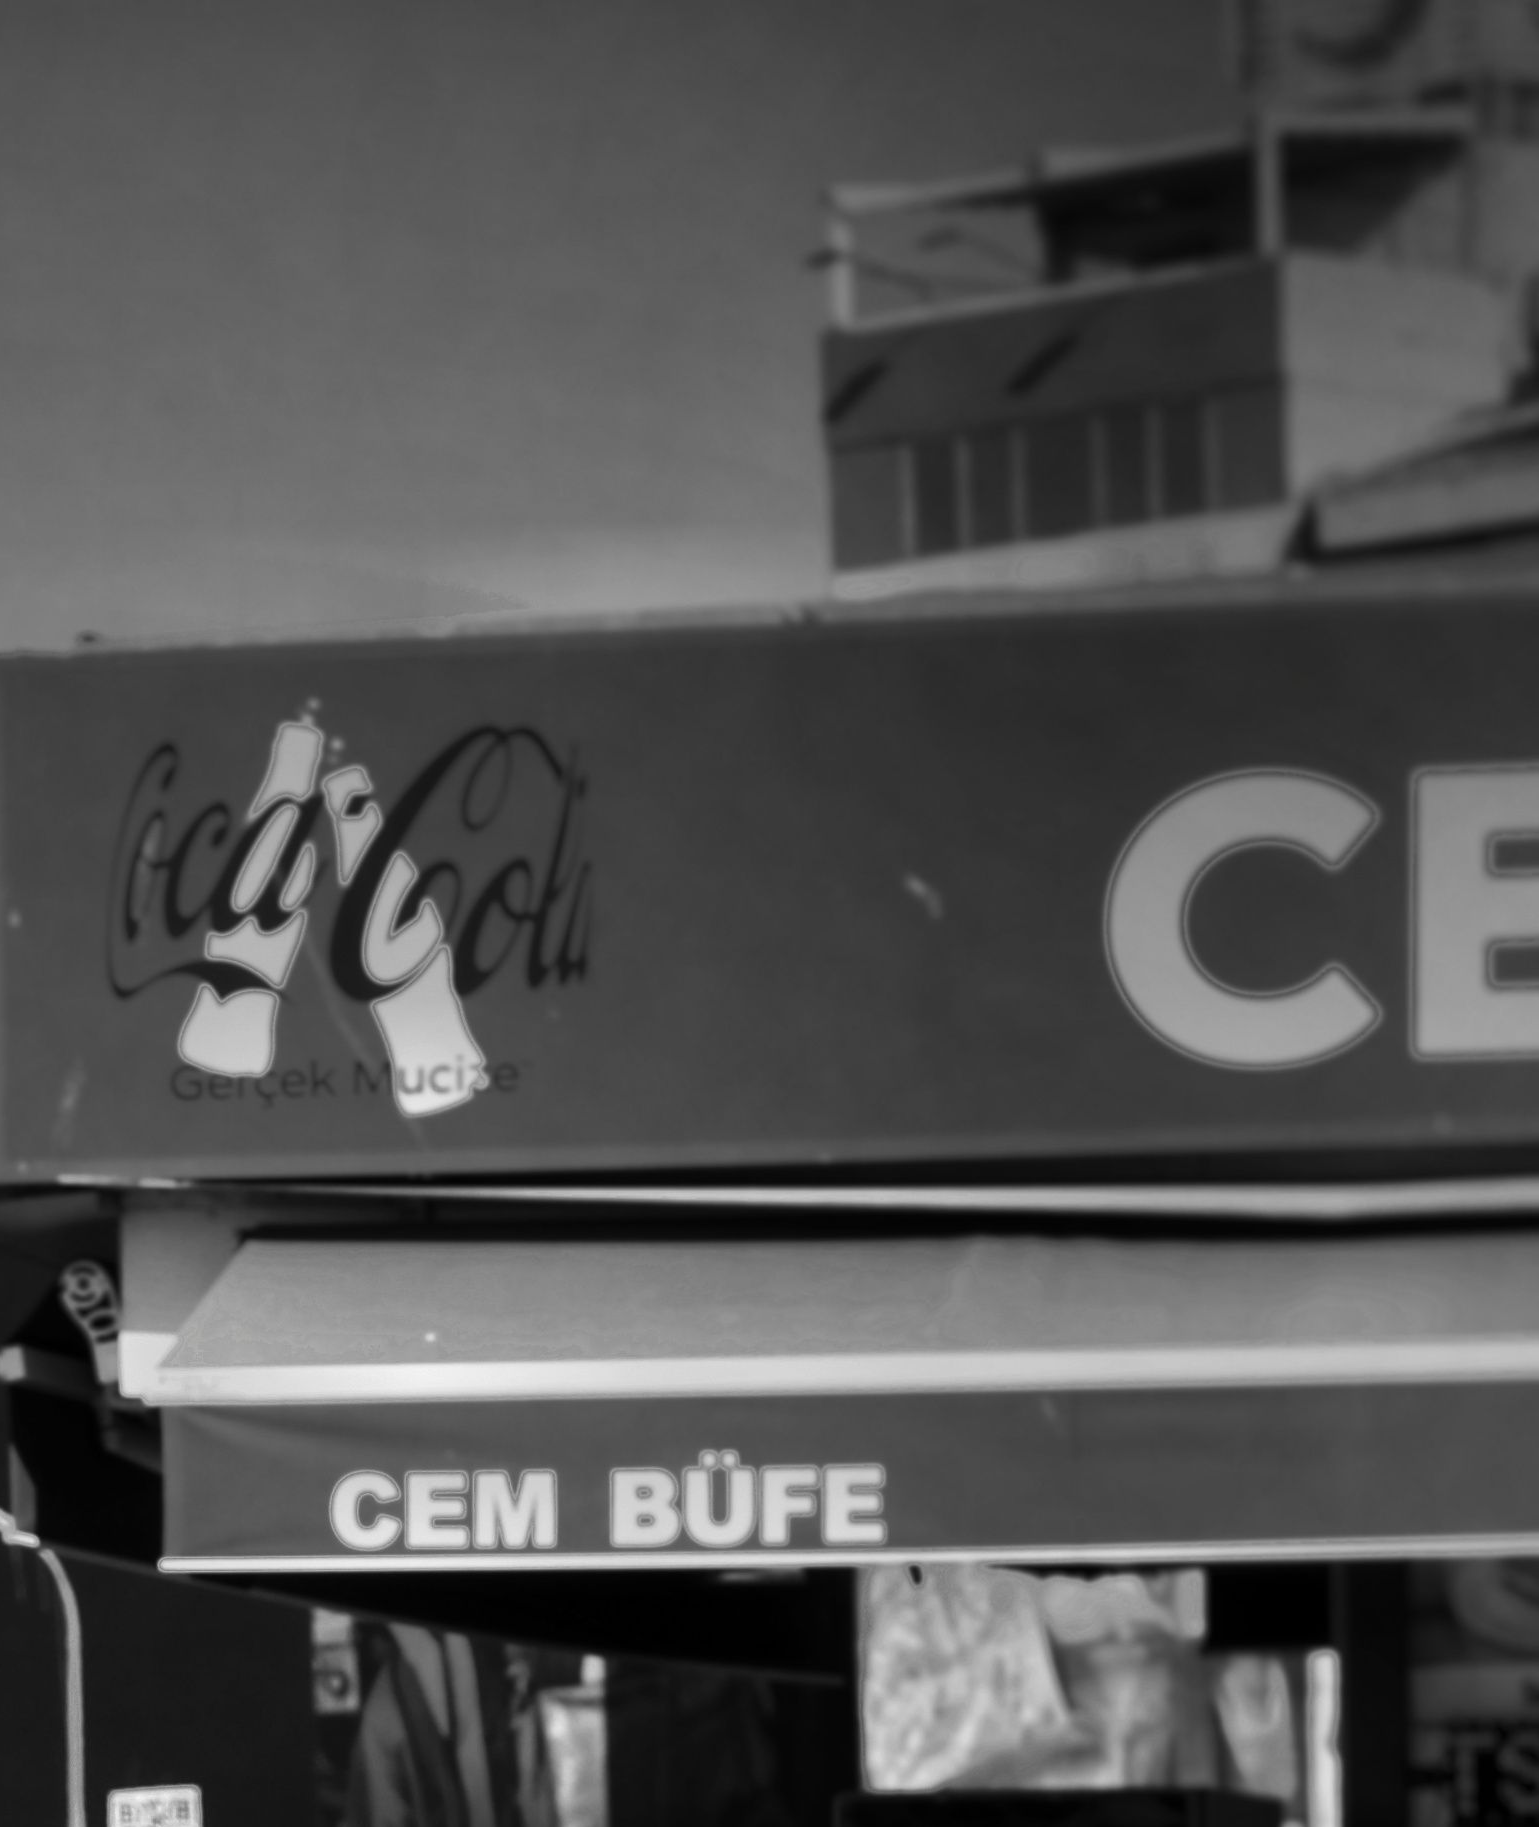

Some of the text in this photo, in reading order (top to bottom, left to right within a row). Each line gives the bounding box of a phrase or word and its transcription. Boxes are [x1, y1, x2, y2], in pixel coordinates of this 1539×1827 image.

[168, 1058, 336, 1108] Gerçek
[329, 1449, 888, 1549] CEM BÜFE
